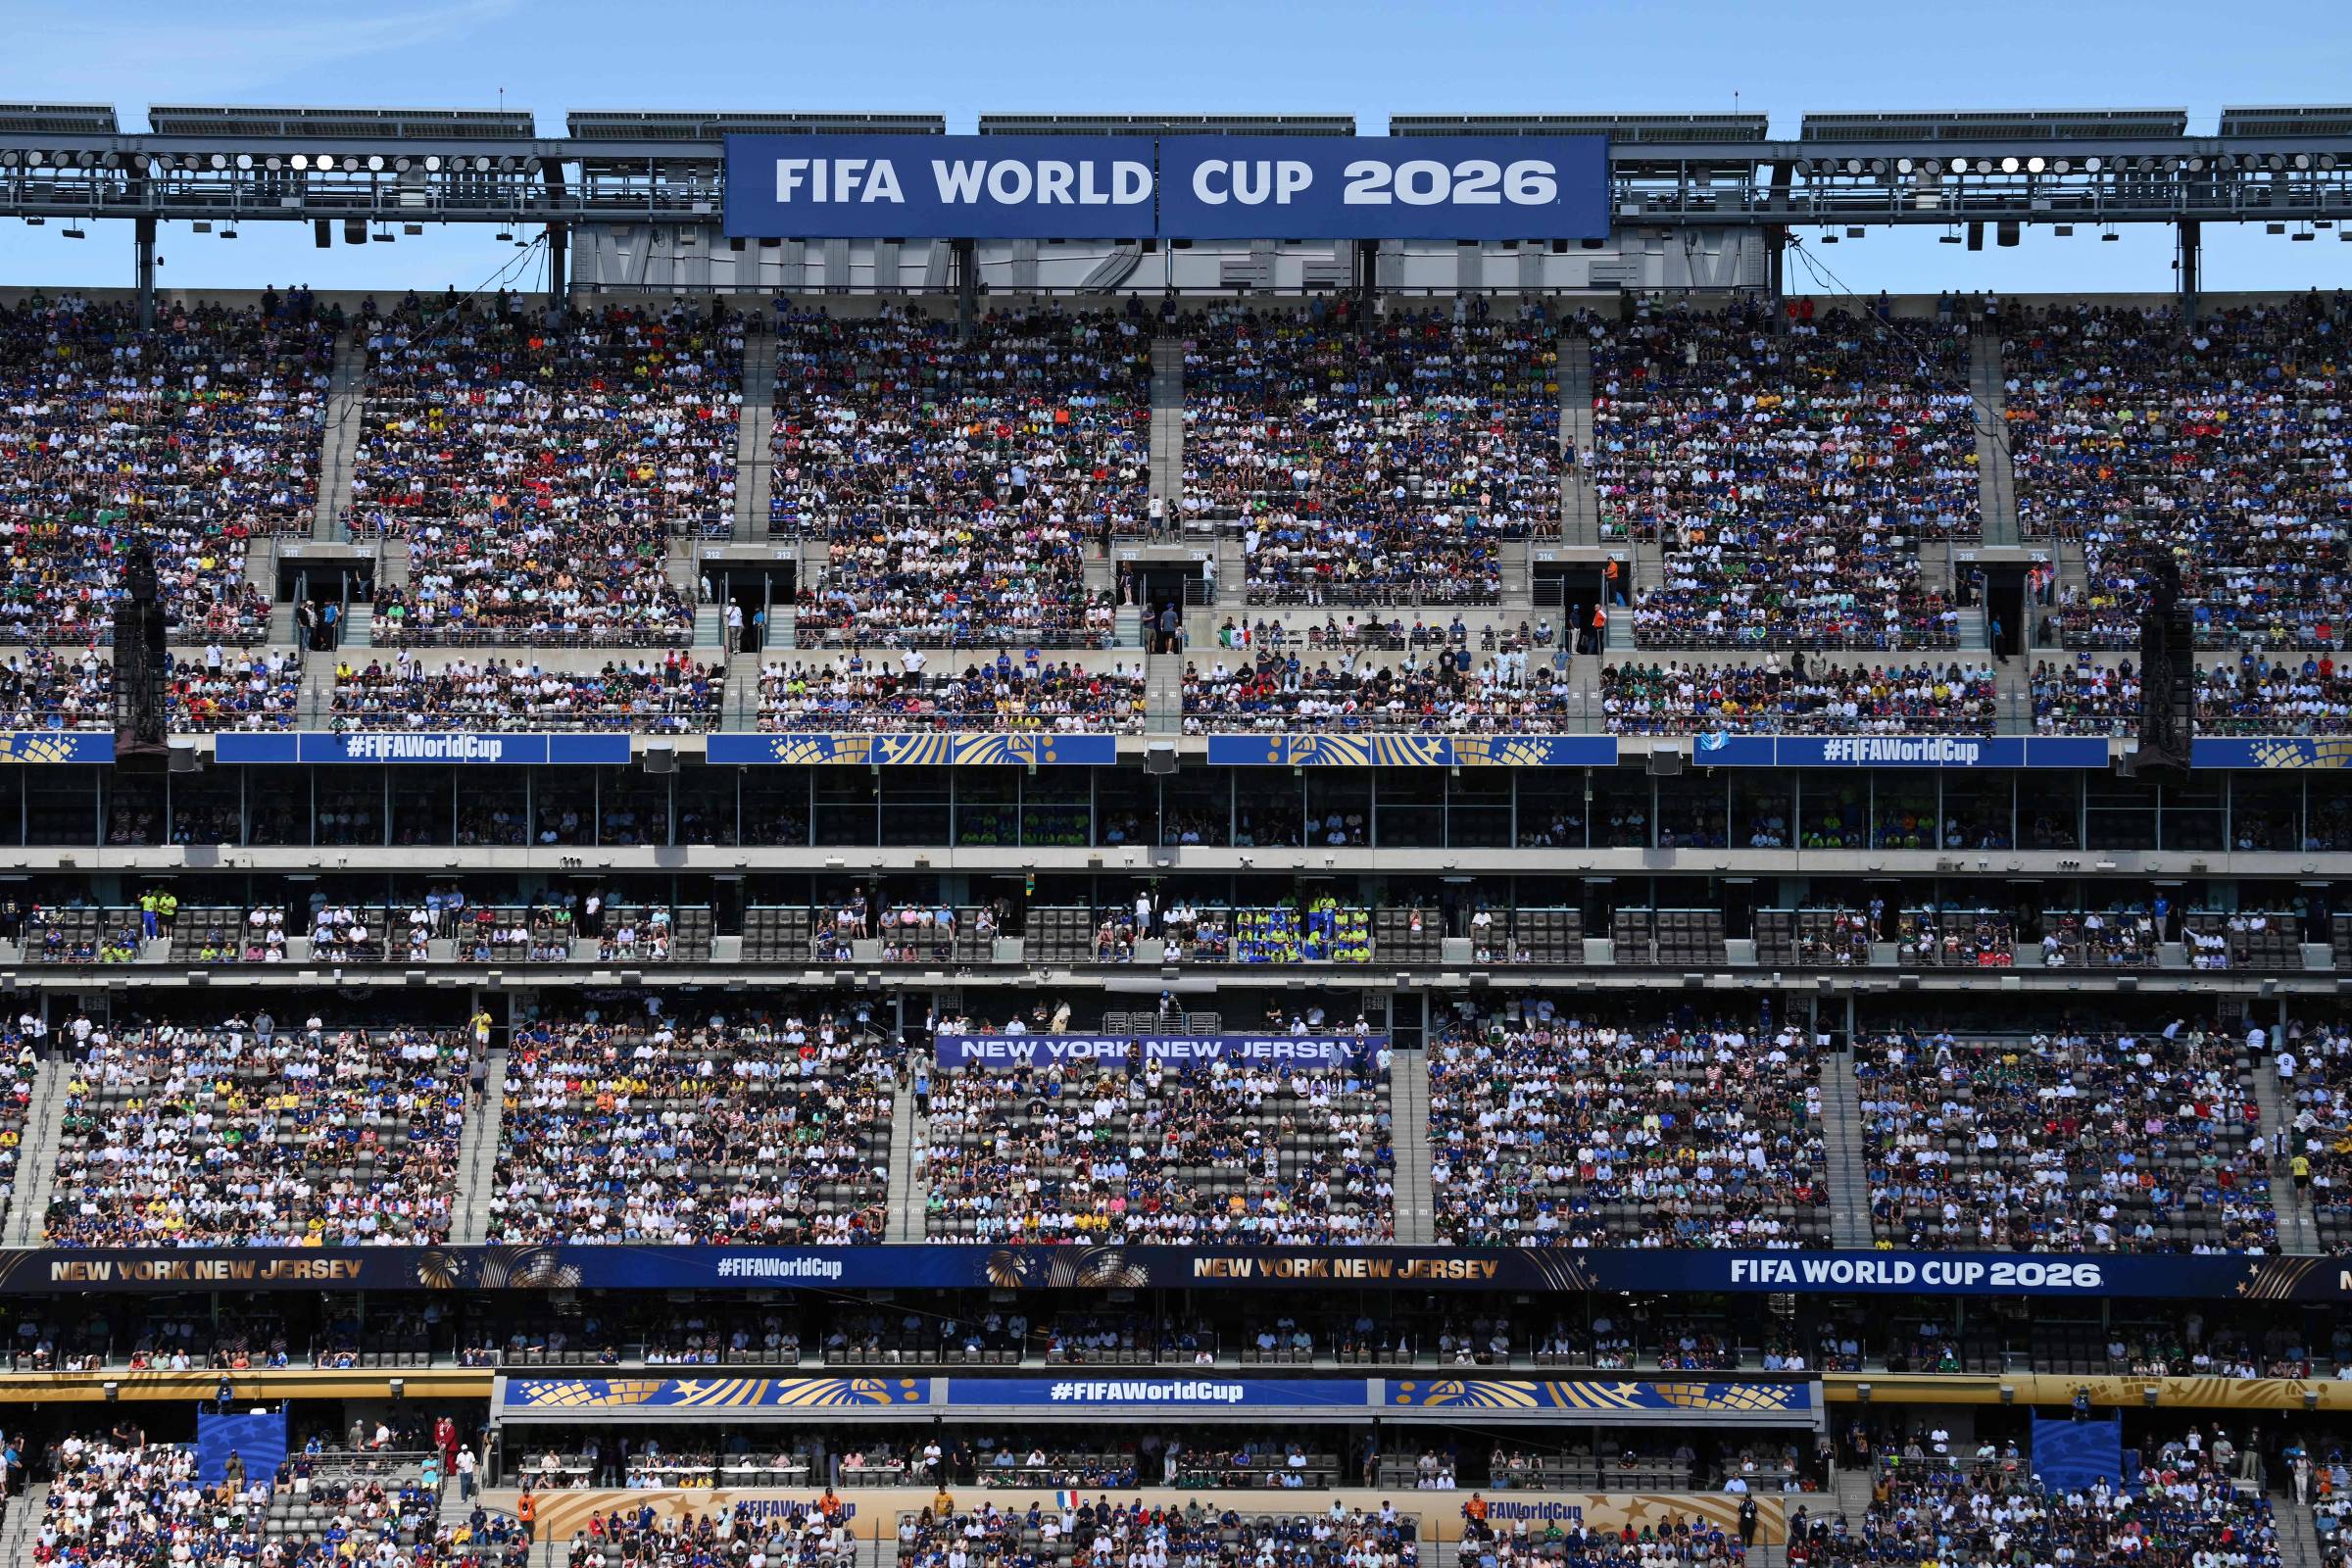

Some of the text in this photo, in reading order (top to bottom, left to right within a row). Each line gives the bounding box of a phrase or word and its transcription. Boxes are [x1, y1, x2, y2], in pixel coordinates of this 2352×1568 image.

[776, 159, 1557, 205] FIFA WORLD CUP 2026
[346, 735, 502, 762] #FIFAWorldCup
[1823, 738, 1979, 765] #FIFAWorldCup
[961, 1041, 1039, 1057] NEW
[1044, 1041, 1132, 1057] YORK
[1146, 1041, 1223, 1057] NEW
[2283, 1057, 2289, 1066] 8
[50, 1258, 363, 1281] NEW YORK NEW JERSEY
[717, 1257, 843, 1280] #FIFAWorldCup
[1194, 1257, 1498, 1280] NEW YORK NEW JERSEY
[1731, 1259, 2101, 1288] FIFA WORLD CUP 2026
[1050, 1382, 1244, 1403] #FIFAWorldCup
